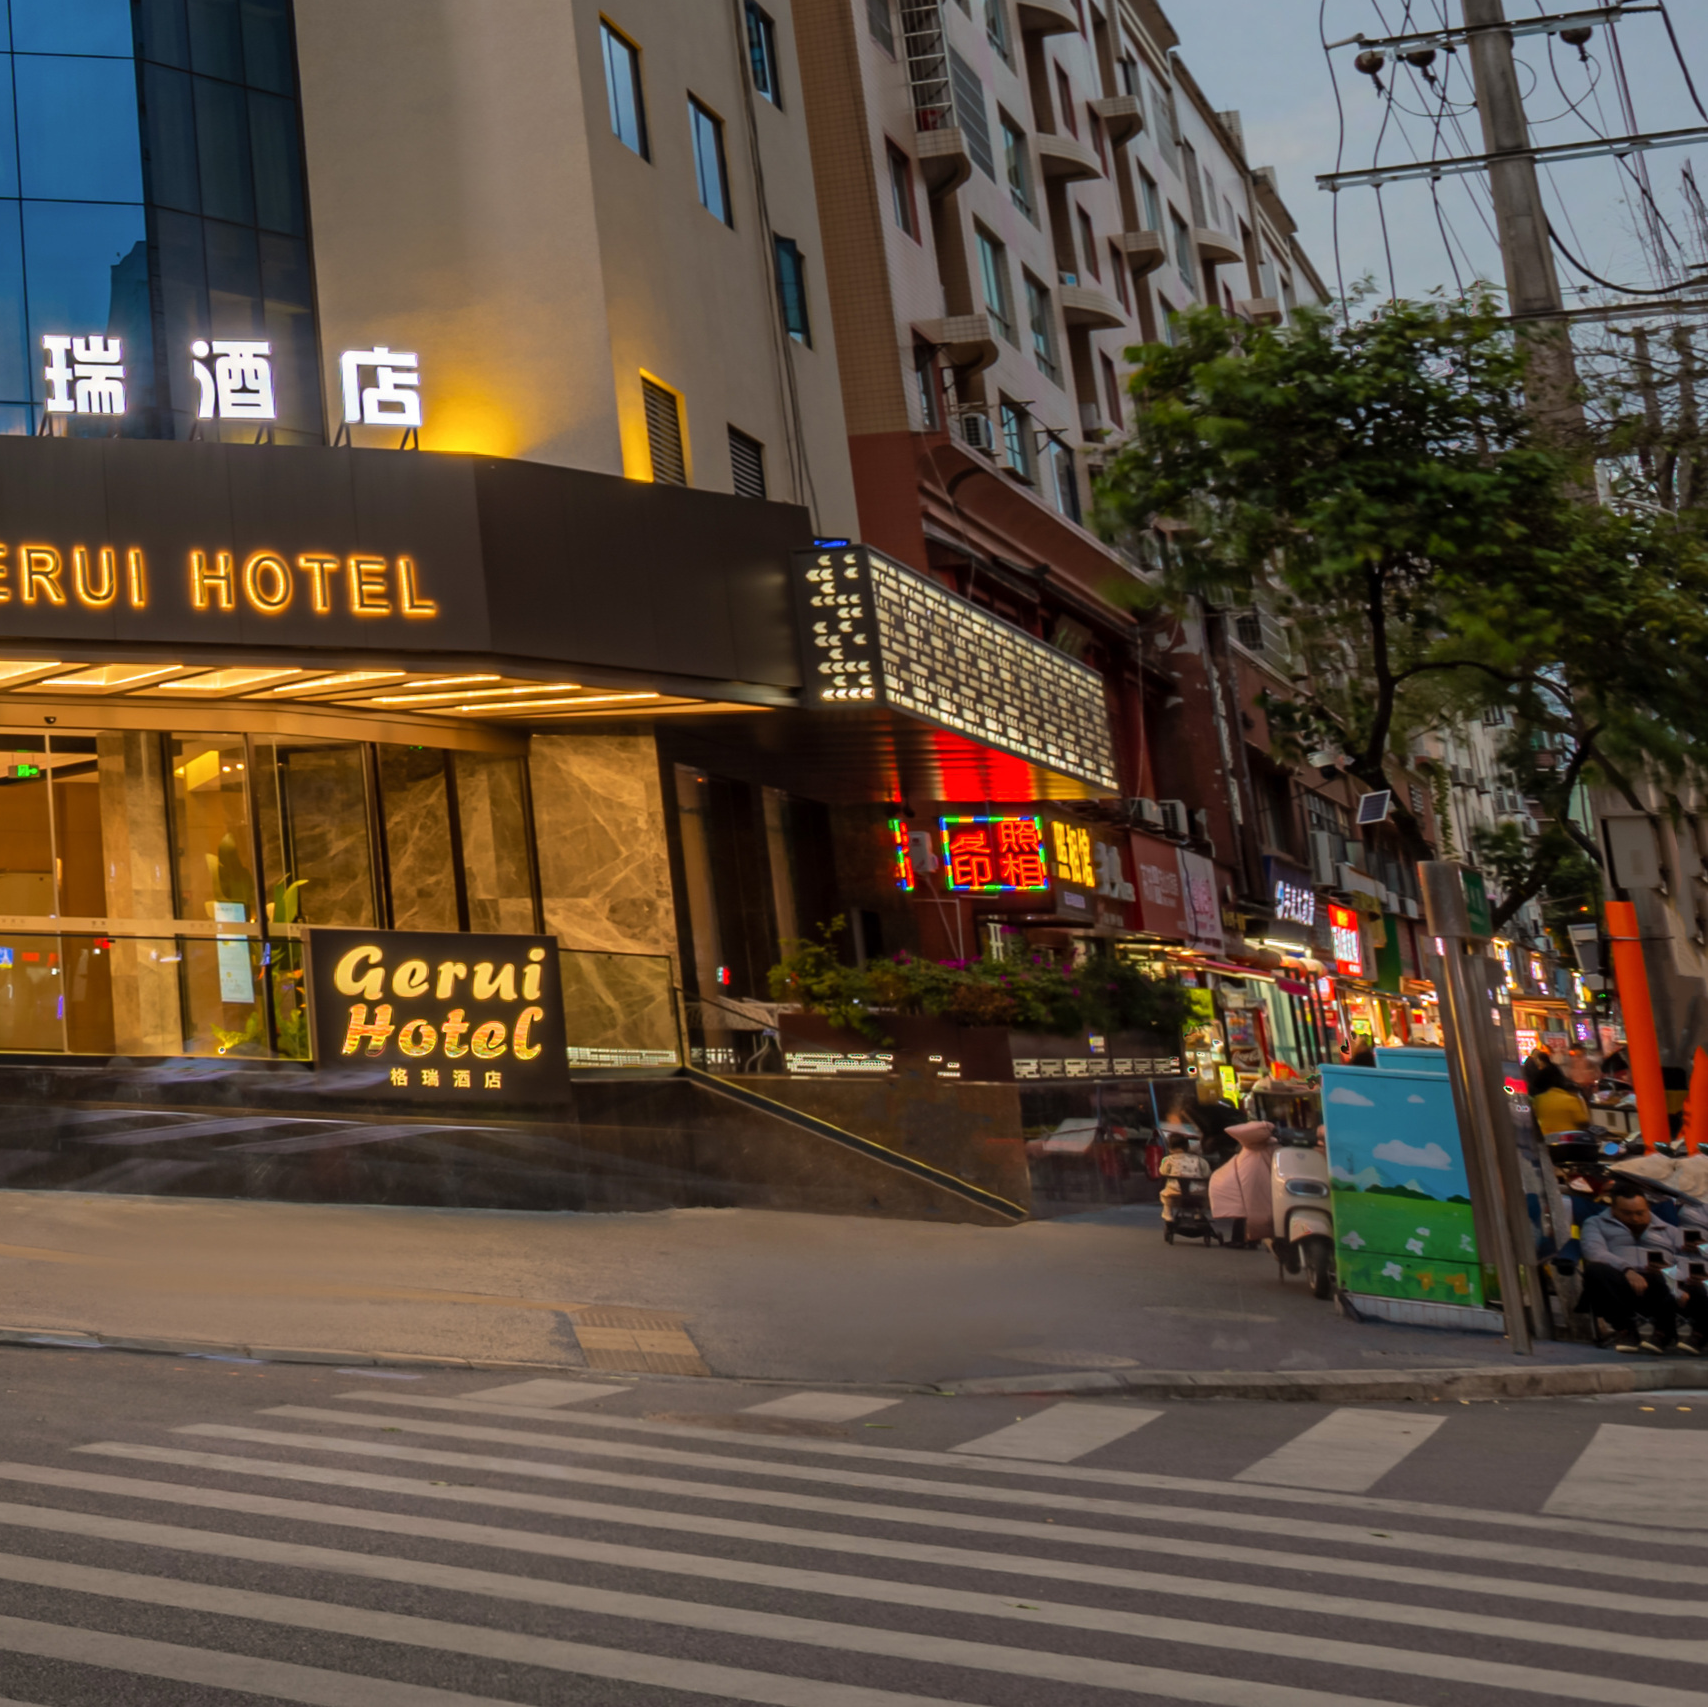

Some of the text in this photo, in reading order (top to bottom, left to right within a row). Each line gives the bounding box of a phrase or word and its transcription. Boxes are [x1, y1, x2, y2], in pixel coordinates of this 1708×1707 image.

[191, 550, 438, 618] HOTEL
[999, 820, 1043, 887] 照相
[333, 945, 546, 1003] Gerui
[340, 1003, 544, 1061] Hotel
[390, 1067, 503, 1090] 格瑞酒店
